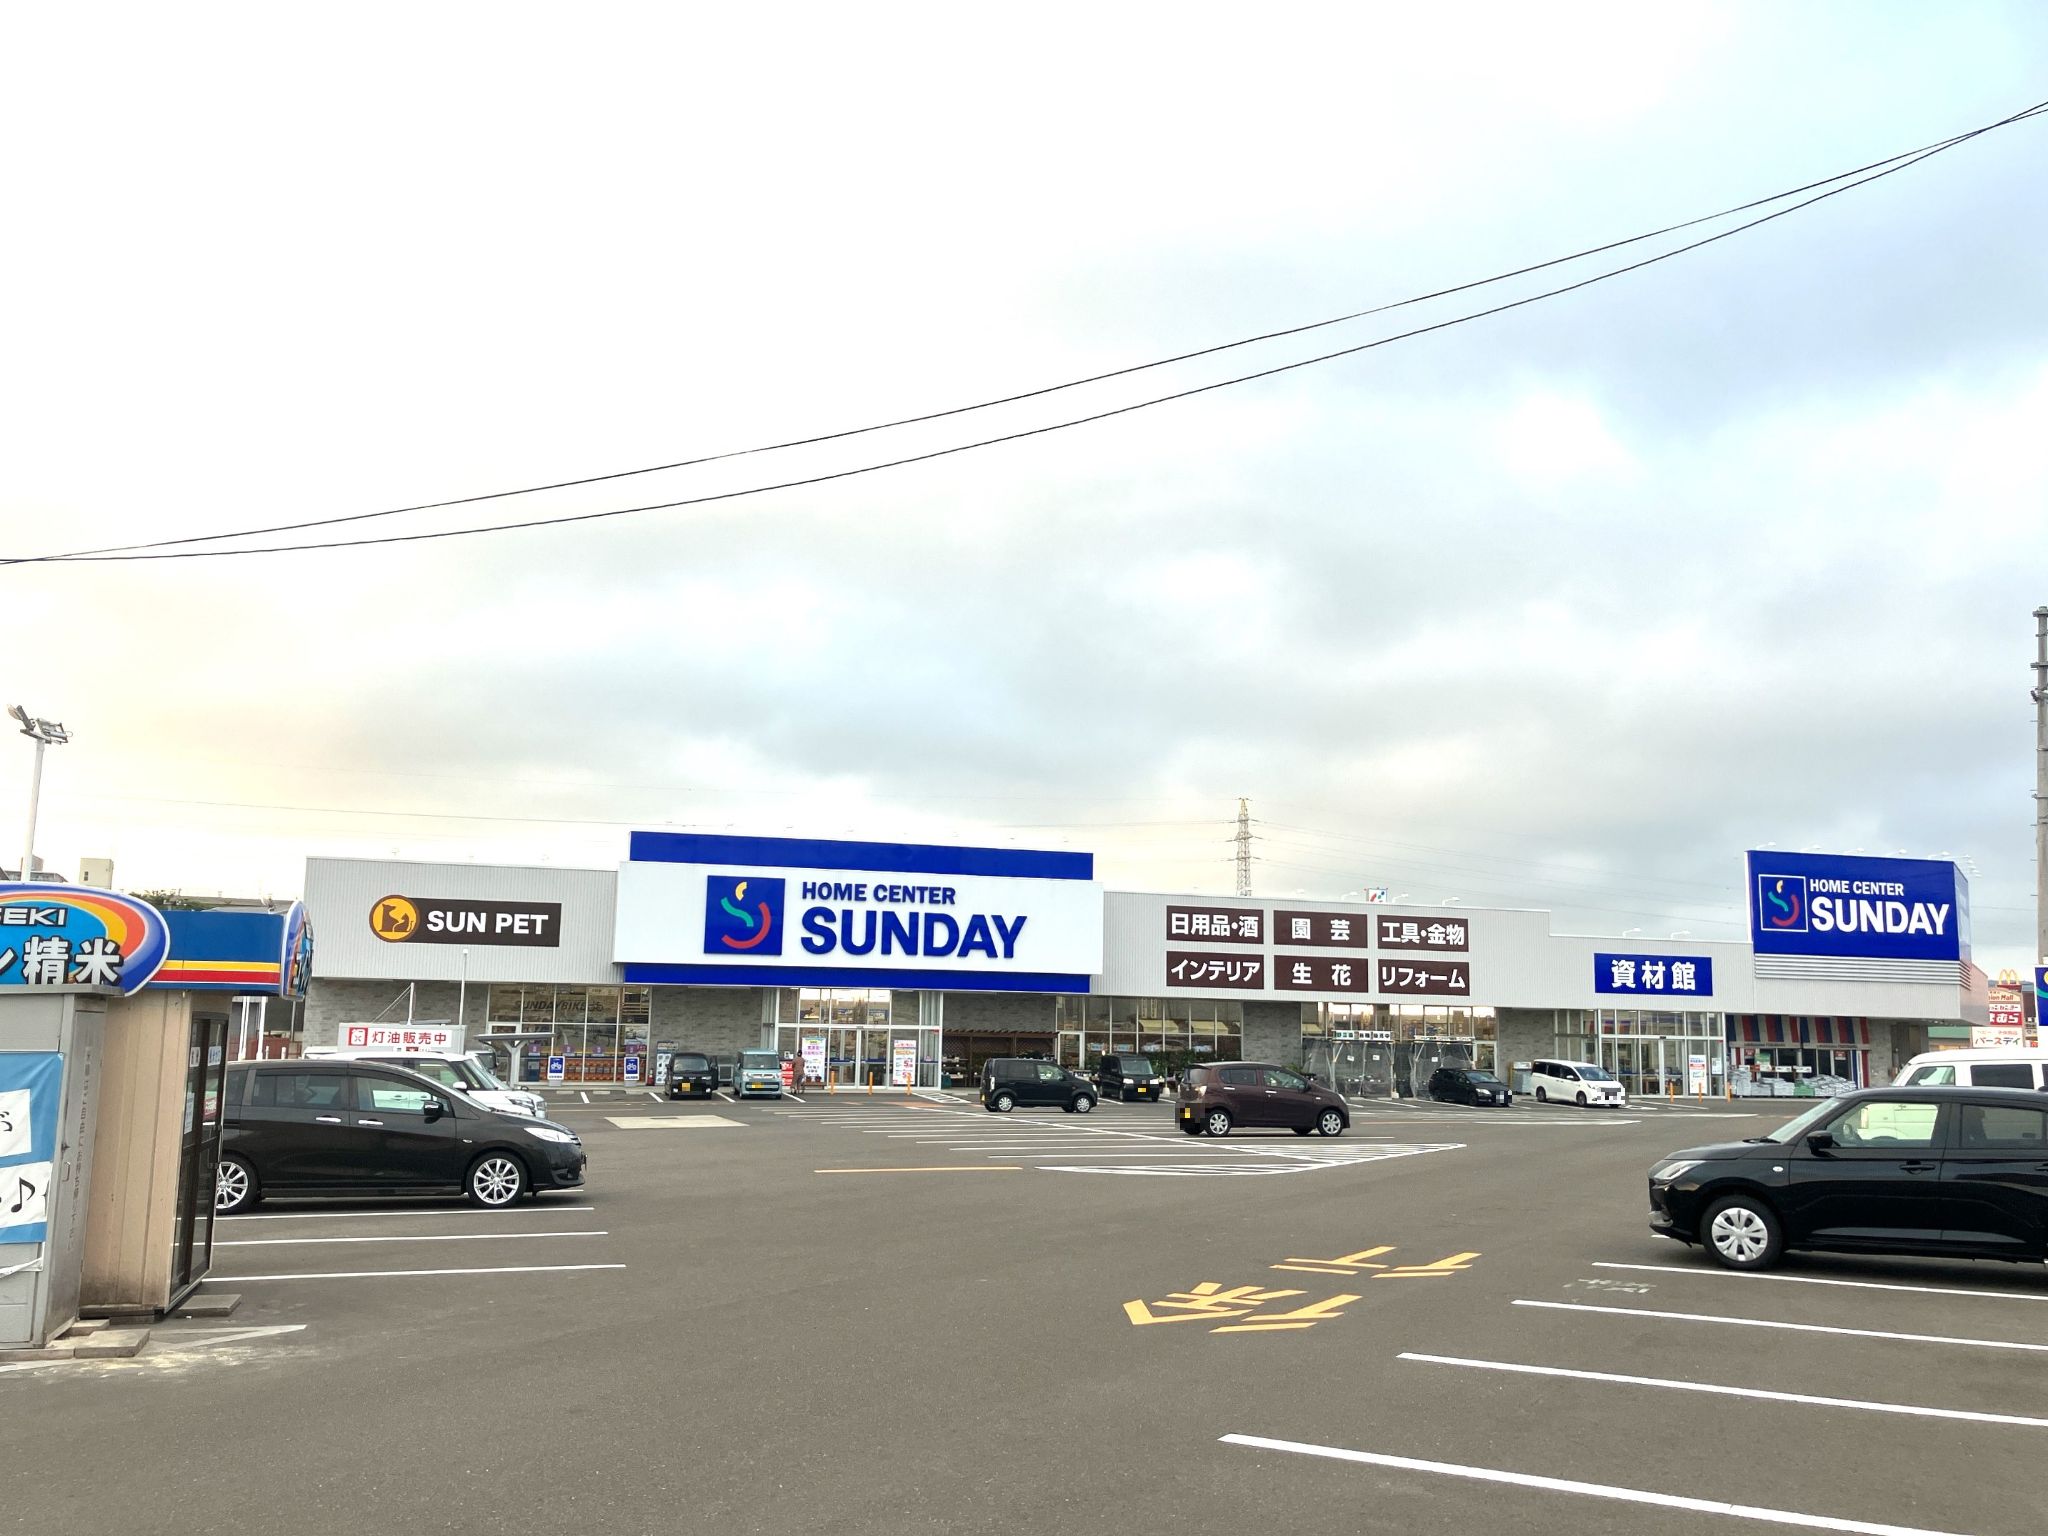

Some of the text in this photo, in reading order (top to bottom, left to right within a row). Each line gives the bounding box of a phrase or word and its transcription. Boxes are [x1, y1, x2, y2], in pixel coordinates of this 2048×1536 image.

[801, 881, 956, 905] HOME CENTER
[1810, 878, 1905, 896] HOME CENTER
[0, 907, 66, 926] EKI
[426, 910, 549, 935] SUN PET
[1811, 896, 1950, 935] SUNDAY
[801, 906, 1028, 959] SUNDAY
[1291, 917, 1351, 941] 園芸
[1170, 959, 1261, 982] インテリア
[1292, 962, 1352, 987] 生花
[1382, 966, 1466, 989] リフォーム
[1611, 959, 1696, 991] 資材館
[371, 1030, 447, 1045] 灯油販売中
